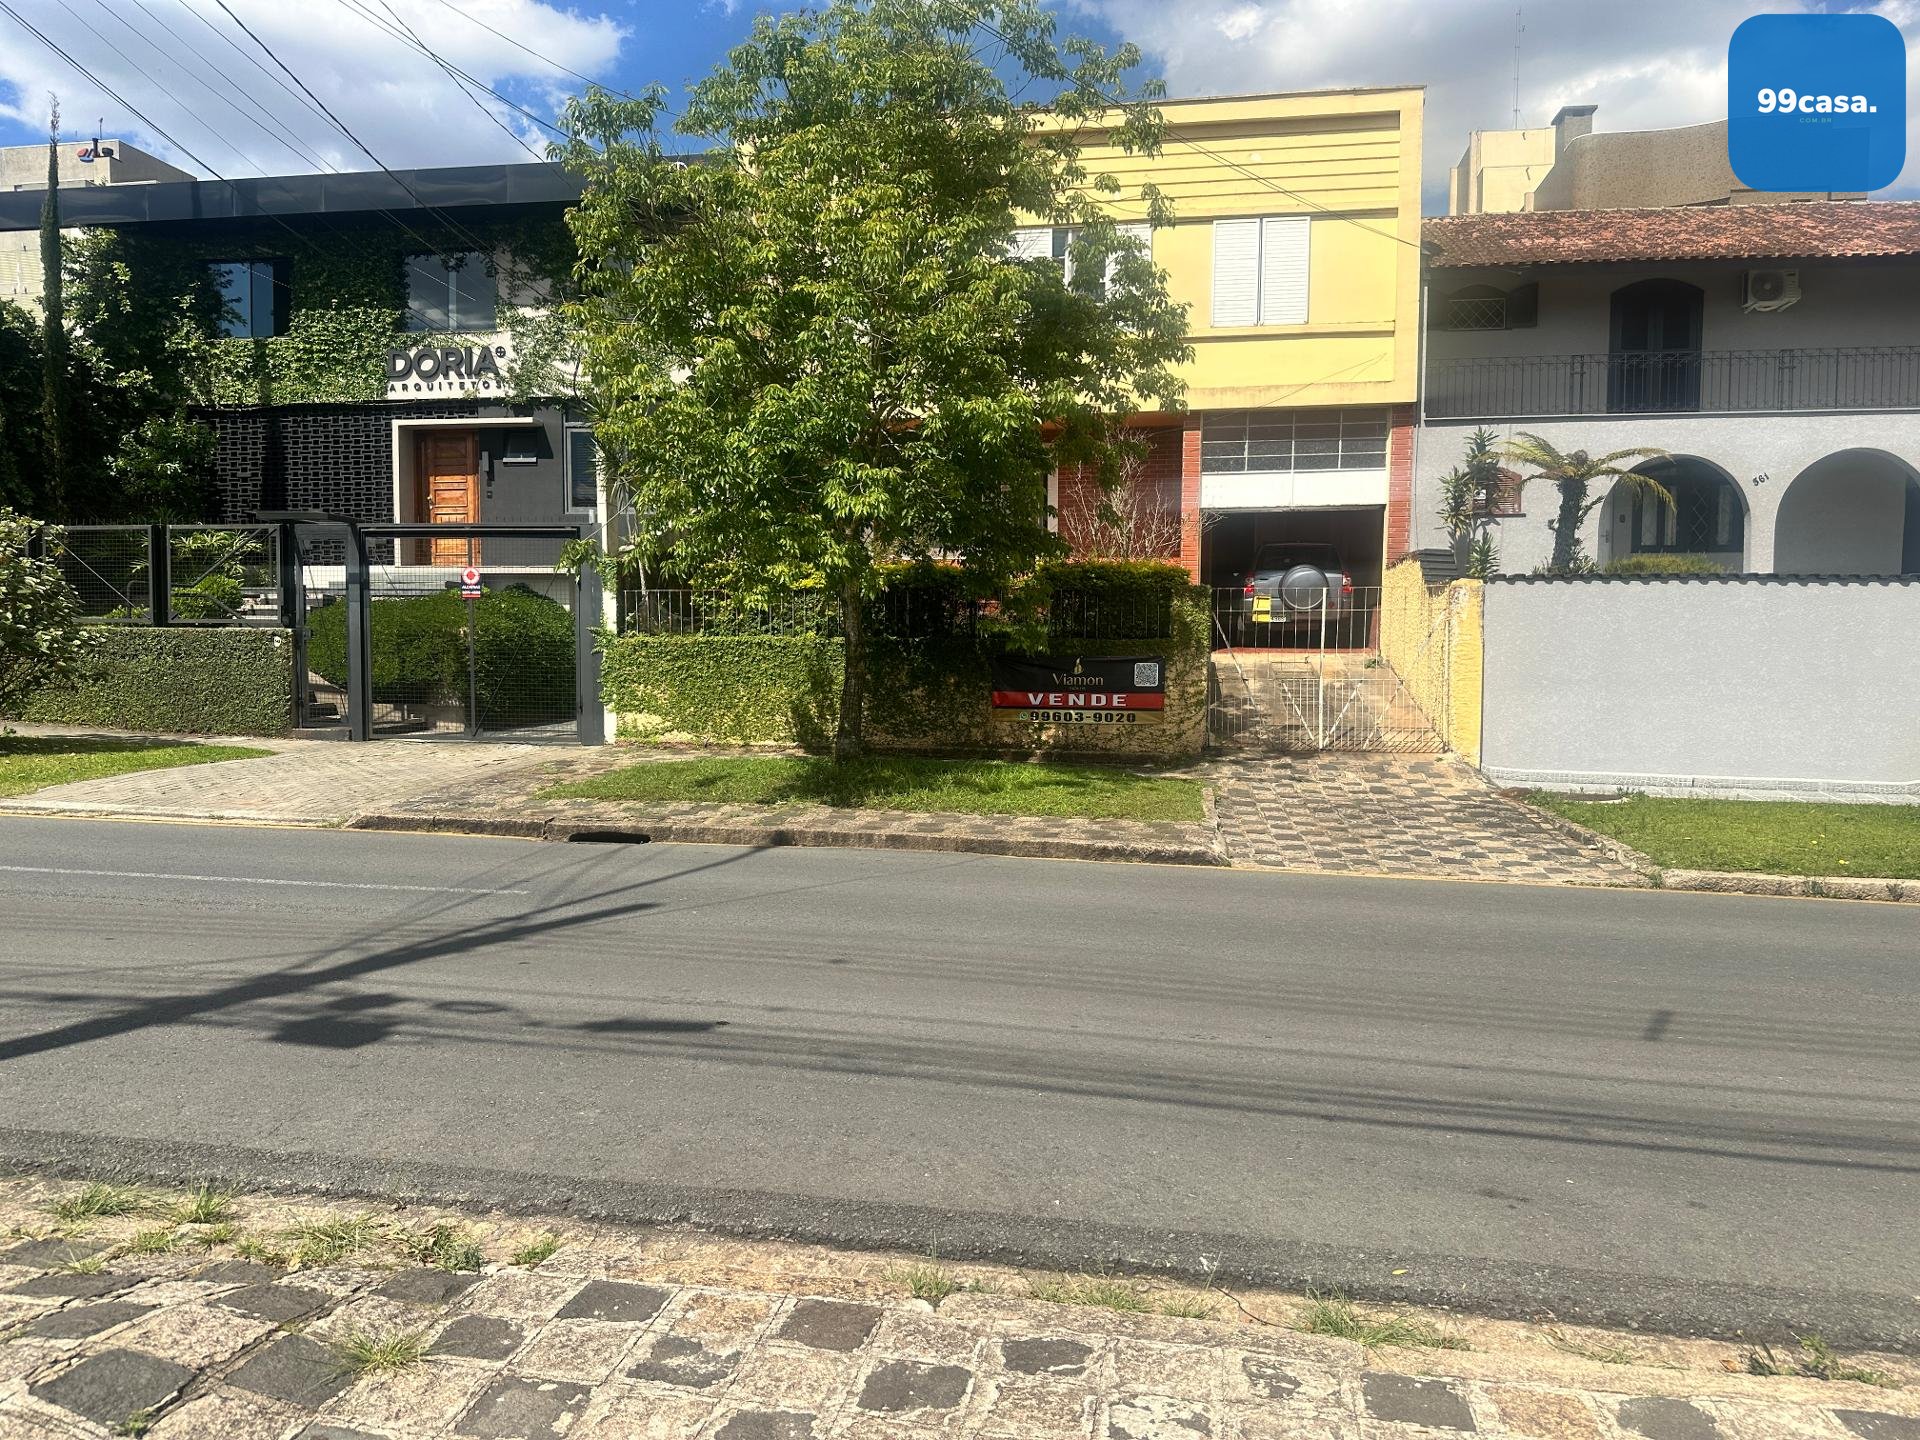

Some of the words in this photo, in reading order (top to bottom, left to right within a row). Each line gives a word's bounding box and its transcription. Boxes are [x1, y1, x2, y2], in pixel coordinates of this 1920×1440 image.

[389, 381, 502, 392] ARQUITETOS
[1052, 673, 1104, 686] Viamon
[1027, 693, 1127, 706] VENDE
[1030, 711, 1136, 723] 99603-9020
